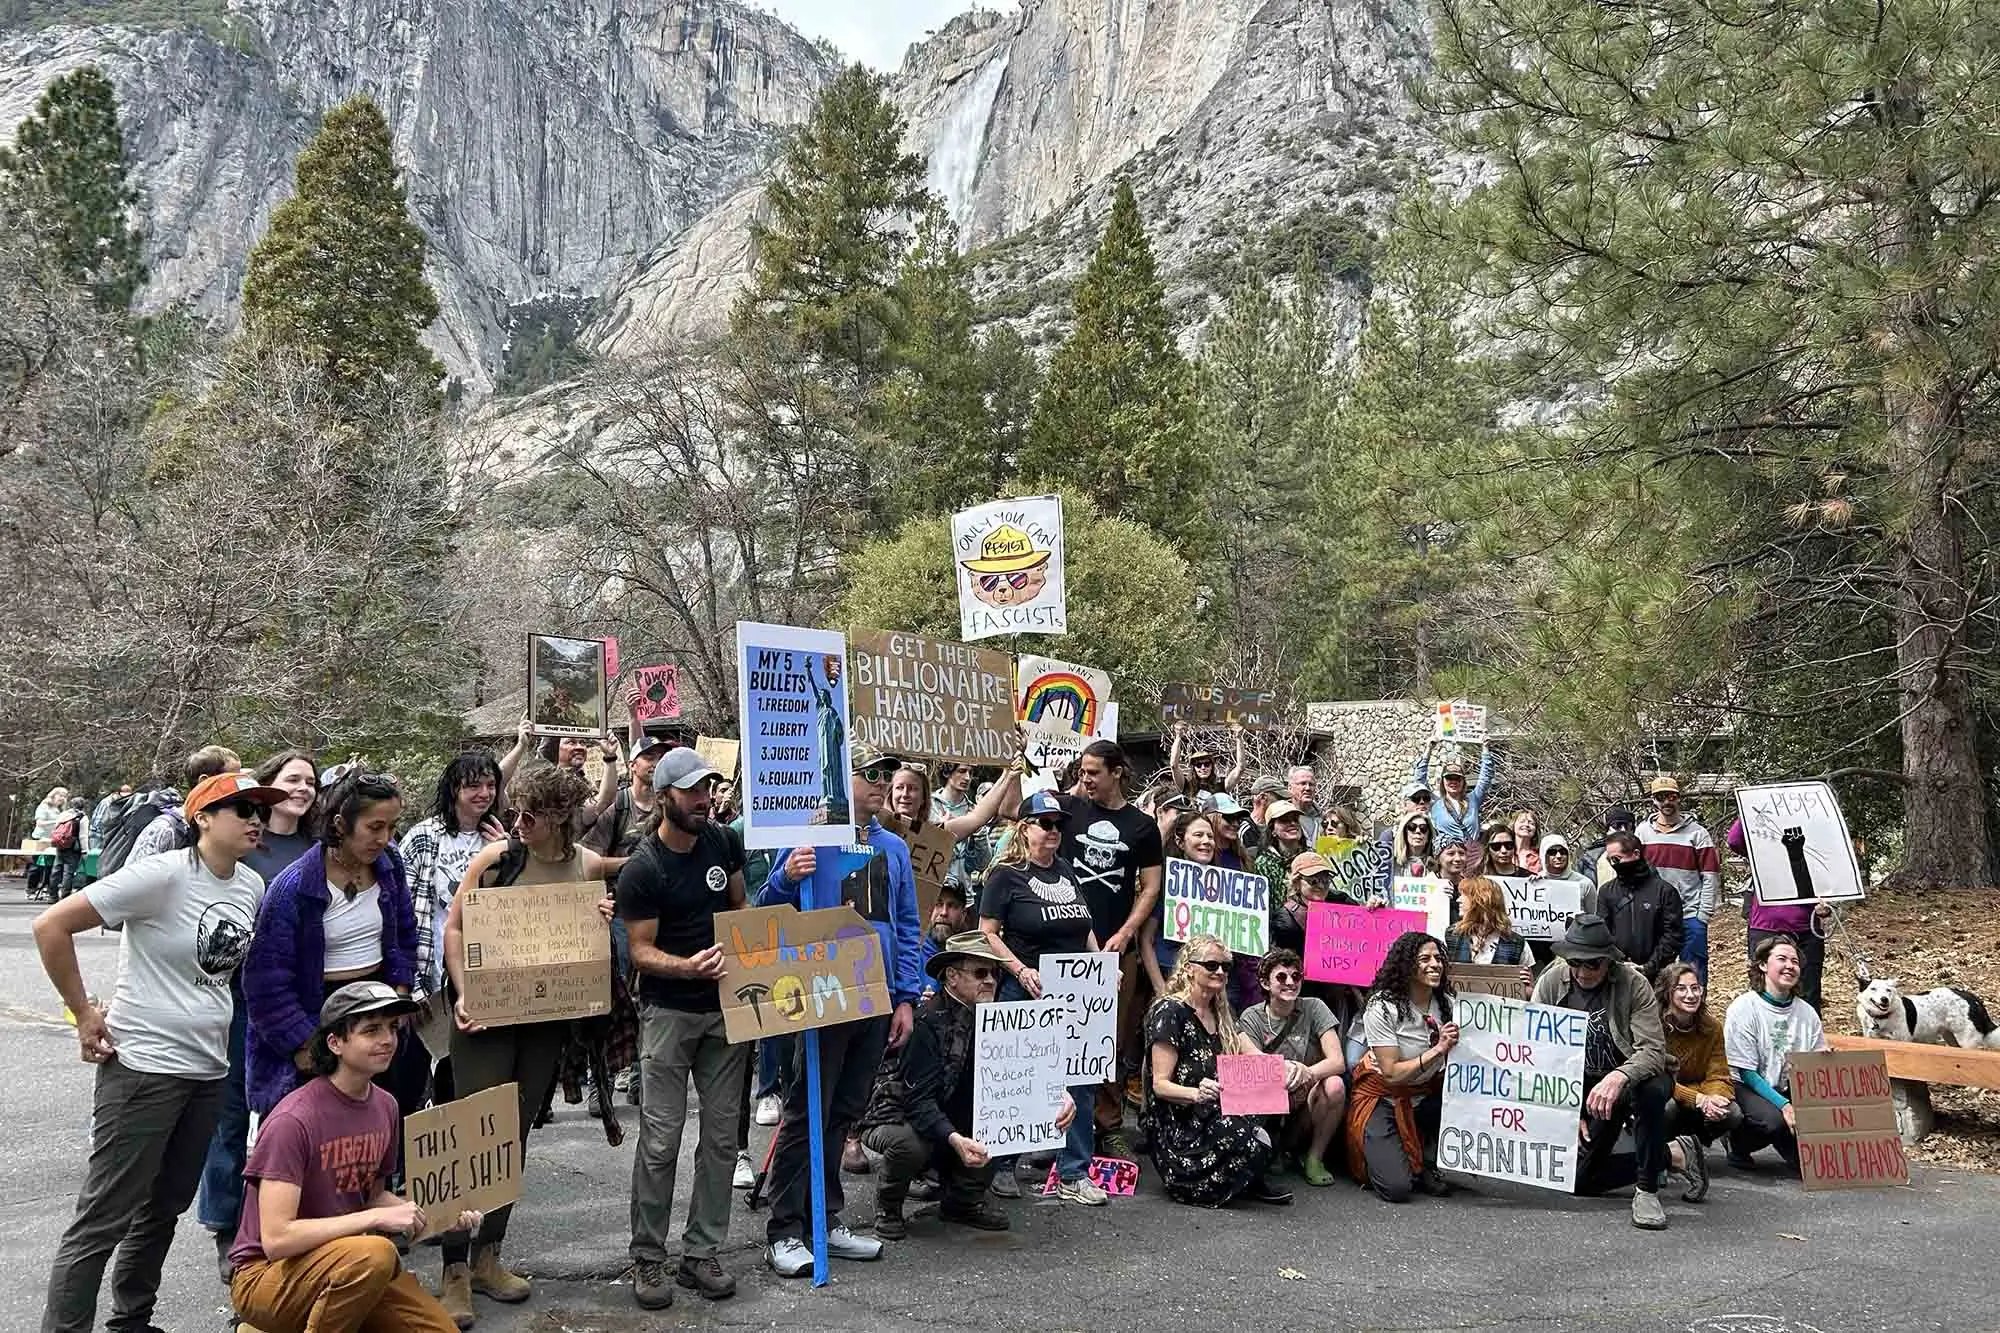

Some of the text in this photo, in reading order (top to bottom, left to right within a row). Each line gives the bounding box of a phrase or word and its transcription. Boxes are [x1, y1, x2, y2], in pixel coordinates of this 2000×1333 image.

[959, 511, 1057, 551] ONLY YOU CAN
[984, 539, 1027, 556] RESIST
[758, 650, 793, 671] MY 5
[890, 634, 981, 670] GET THEIR
[635, 669, 676, 690] POWER
[750, 671, 806, 693] BULLETS
[856, 651, 1009, 705] BILLIONAIRE
[1068, 663, 1094, 681] WANT
[757, 696, 809, 714] 1.FREEDOM
[1166, 684, 1224, 705] ANDS
[874, 687, 994, 729] HANDS OFF
[760, 721, 809, 737] 2.LIBERTY
[761, 746, 810, 761] 3.JUSTICE
[758, 771, 814, 786] 4.EQUALITY
[752, 795, 821, 811] 5.DEMOCRACY
[1167, 860, 1267, 911] STRONGER
[1503, 880, 1546, 903] WE
[1041, 906, 1048, 921] I
[1166, 898, 1265, 955] TOGETHER
[982, 1007, 1065, 1032] HANDS OFF
[1077, 993, 1114, 1026] you
[1459, 997, 1586, 1048] DON'T TAKE
[981, 1035, 1061, 1068] Social Security
[1495, 1041, 1535, 1066] OUR
[981, 1065, 1035, 1085] Medicare
[1447, 1063, 1582, 1107] PUBLIC LANDS
[981, 1080, 1032, 1102] Medicaid
[1491, 1107, 1527, 1133] FOR
[1832, 1107, 1855, 1129] IN
[413, 1113, 496, 1158] THIS IS
[319, 1131, 389, 1171] VIRGINI
[1439, 1126, 1567, 1183] GRANITE
[413, 1140, 514, 1209] DOGE SH!T
